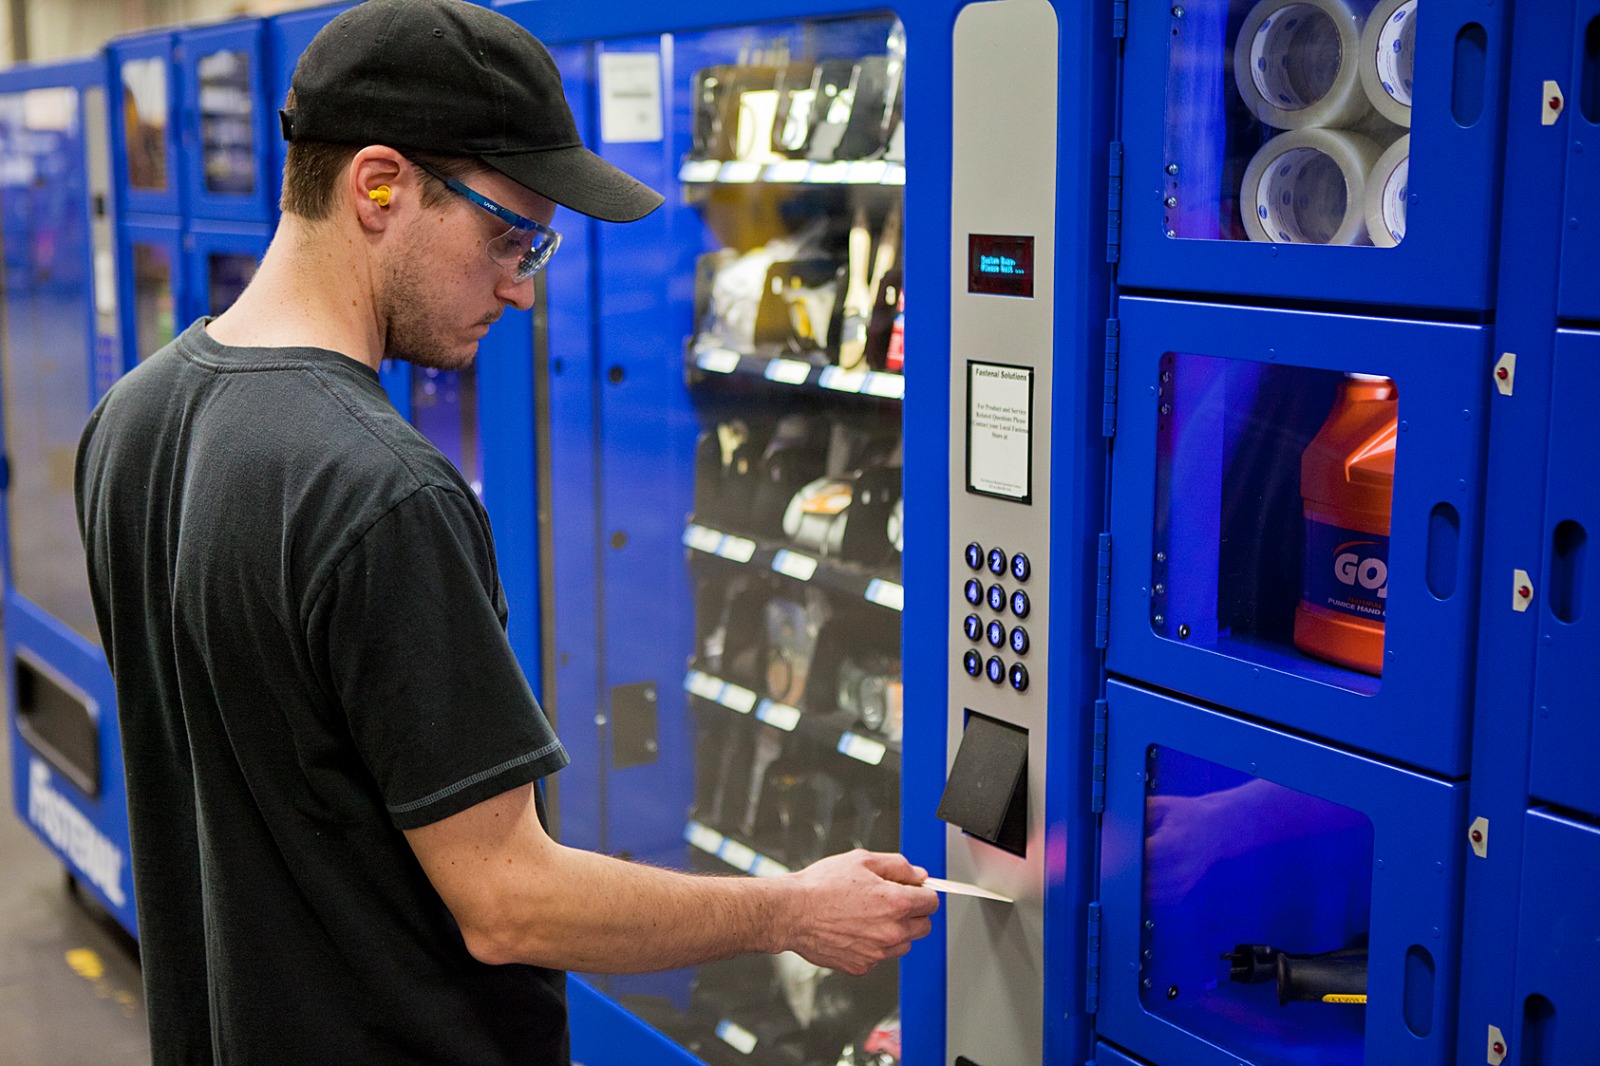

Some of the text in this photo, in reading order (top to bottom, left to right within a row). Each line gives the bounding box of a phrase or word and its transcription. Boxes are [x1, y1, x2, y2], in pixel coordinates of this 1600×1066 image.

[975, 367, 1028, 382] Fastenal Solutions
[975, 411, 1026, 424] Related Questions Please
[985, 403, 1002, 413] Product
[1011, 408, 1027, 416] Service
[999, 423, 1011, 431] Local
[991, 551, 1001, 572] 2
[1015, 557, 1025, 577] 3
[968, 582, 1025, 615] 4 5 6
[1327, 597, 1356, 610] PUMICE
[1356, 604, 1382, 616] HAND
[967, 617, 1024, 651] 7 8 9
[990, 660, 999, 681] 0
